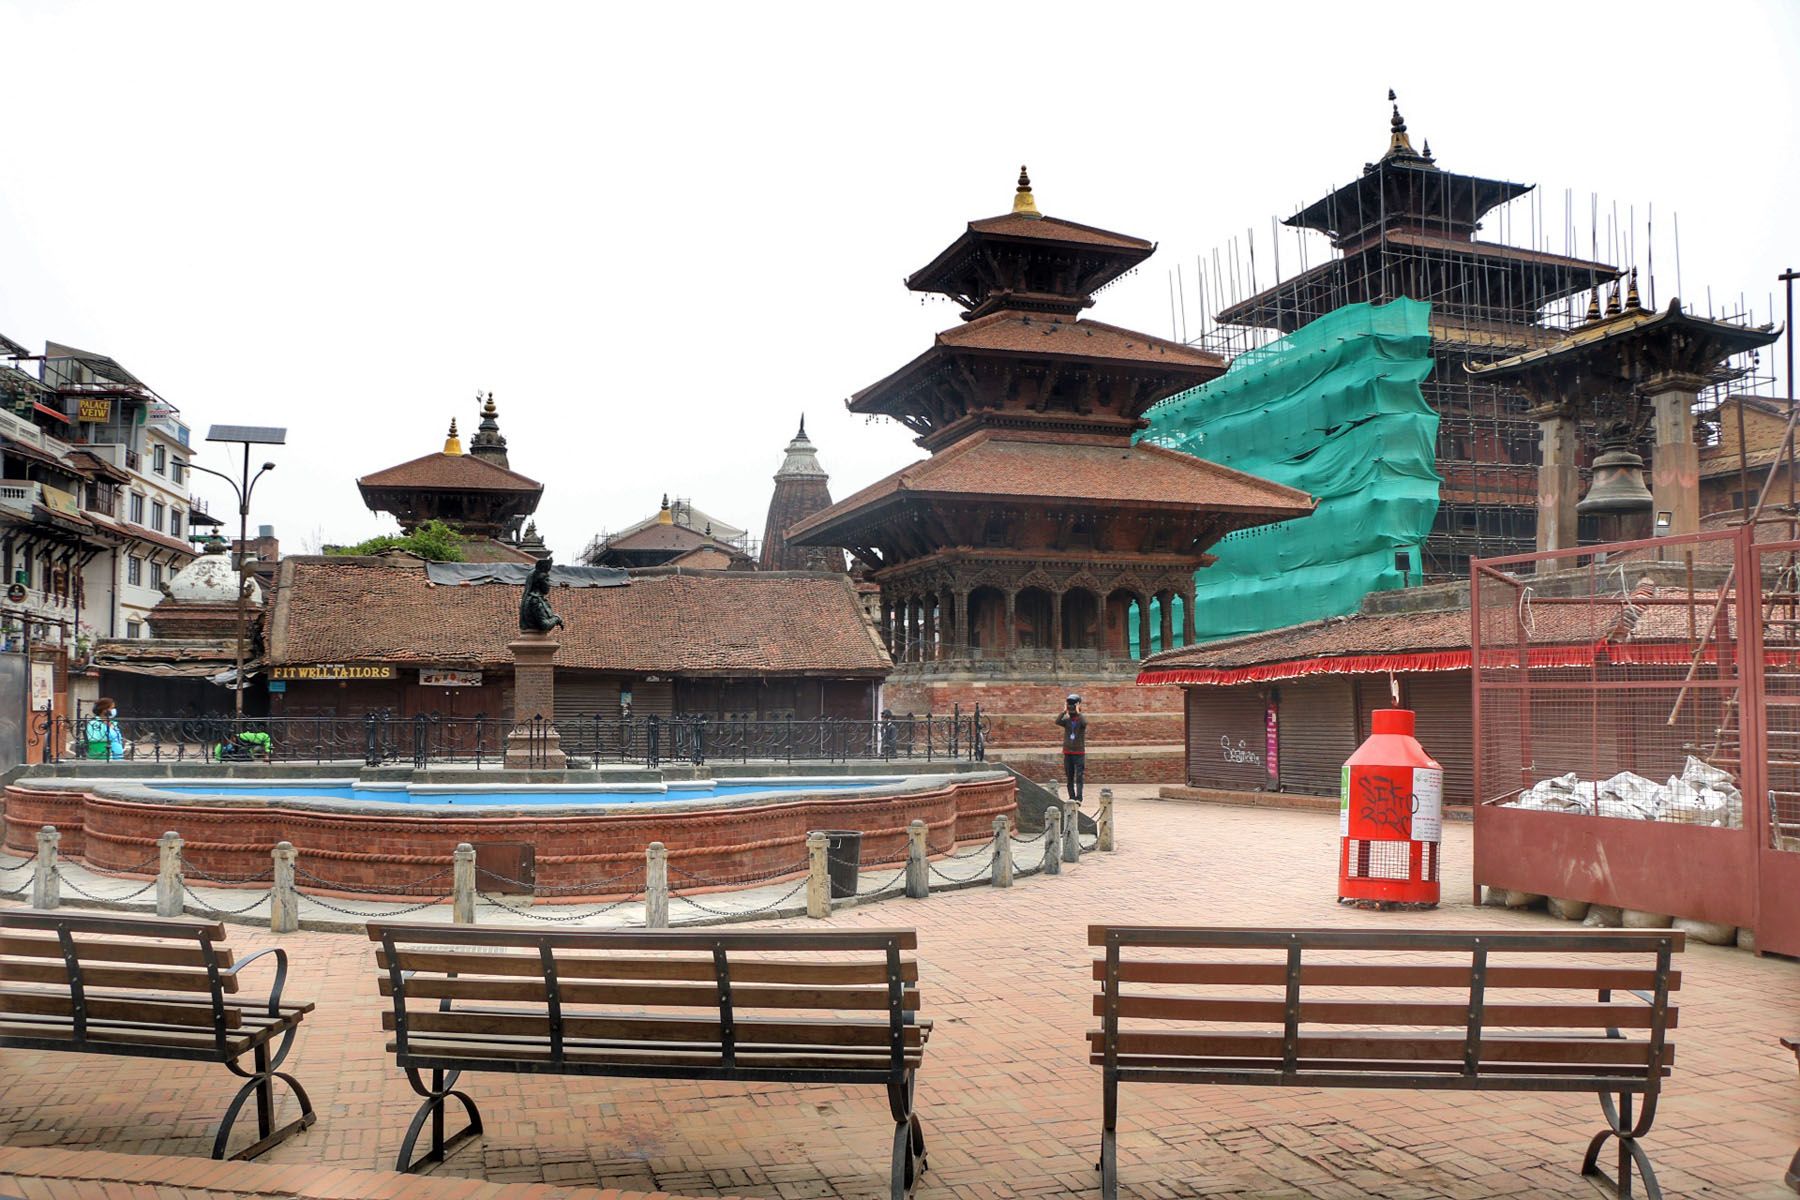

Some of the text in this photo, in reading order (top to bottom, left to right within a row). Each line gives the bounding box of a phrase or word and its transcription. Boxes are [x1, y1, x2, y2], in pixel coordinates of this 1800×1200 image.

[80, 400, 108, 409] PALACE
[81, 408, 107, 417] VEIW
[274, 667, 390, 678] FIT WELL TAILORS
